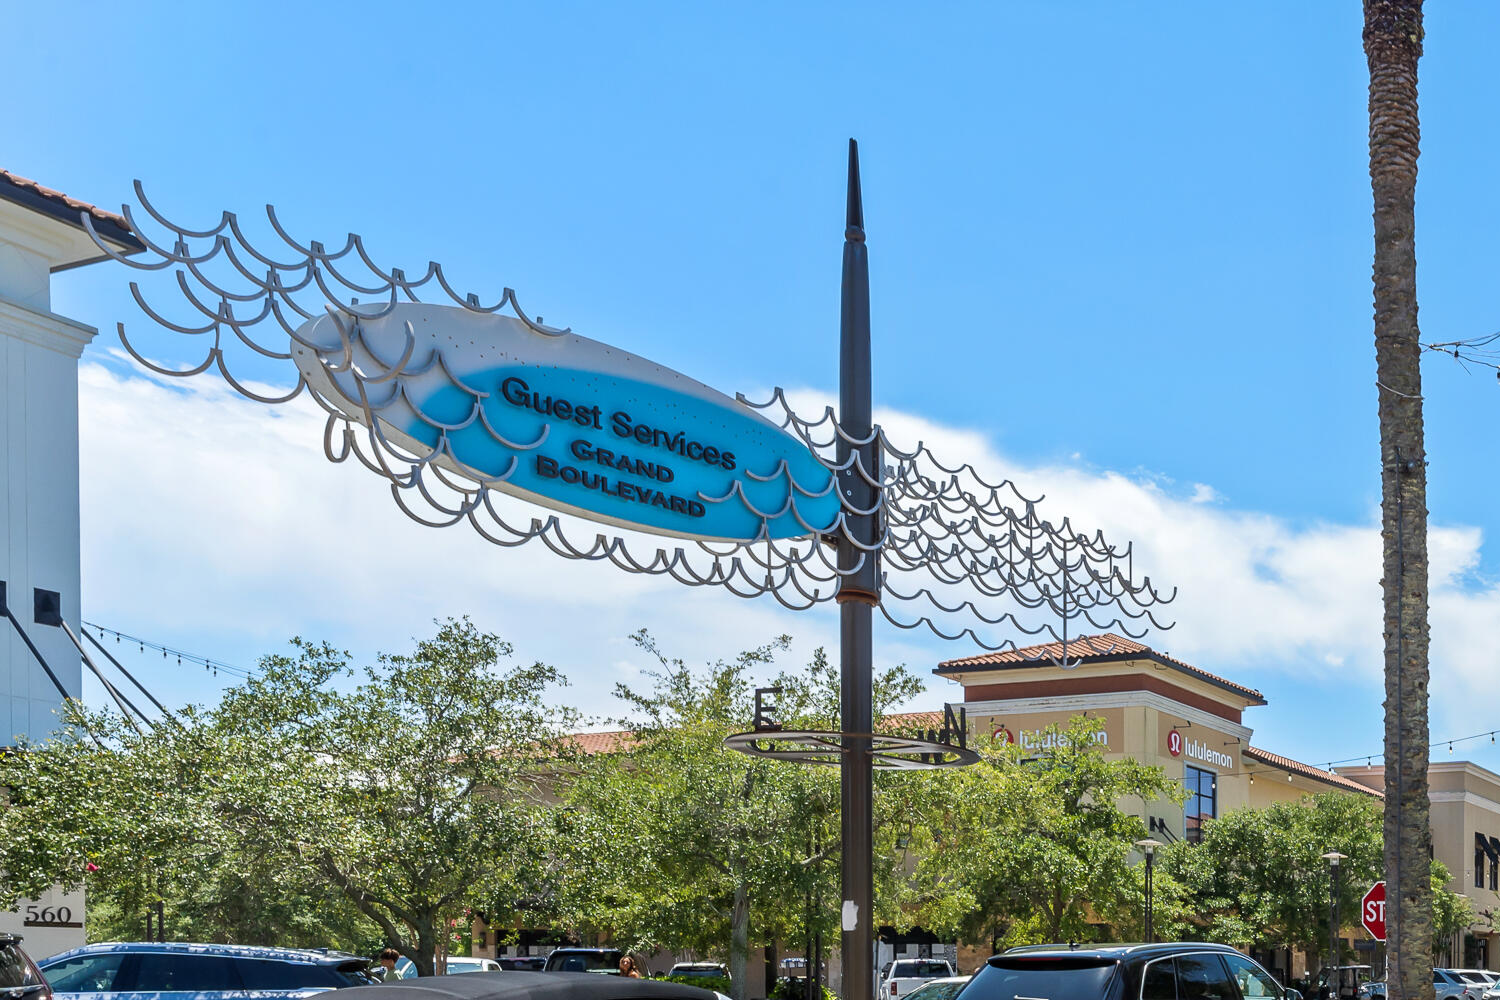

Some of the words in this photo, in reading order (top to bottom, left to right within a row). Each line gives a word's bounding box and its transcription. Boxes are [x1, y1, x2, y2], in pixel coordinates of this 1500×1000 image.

[501, 376, 603, 430] Guest
[610, 411, 737, 471] Services
[571, 439, 674, 483] GRAND
[536, 454, 706, 518] BOULEVARD
[944, 702, 966, 750] N
[1019, 729, 1108, 749] lululeon
[1184, 736, 1233, 769] lululemon
[25, 905, 72, 923] 560
[1365, 900, 1386, 922] ST
